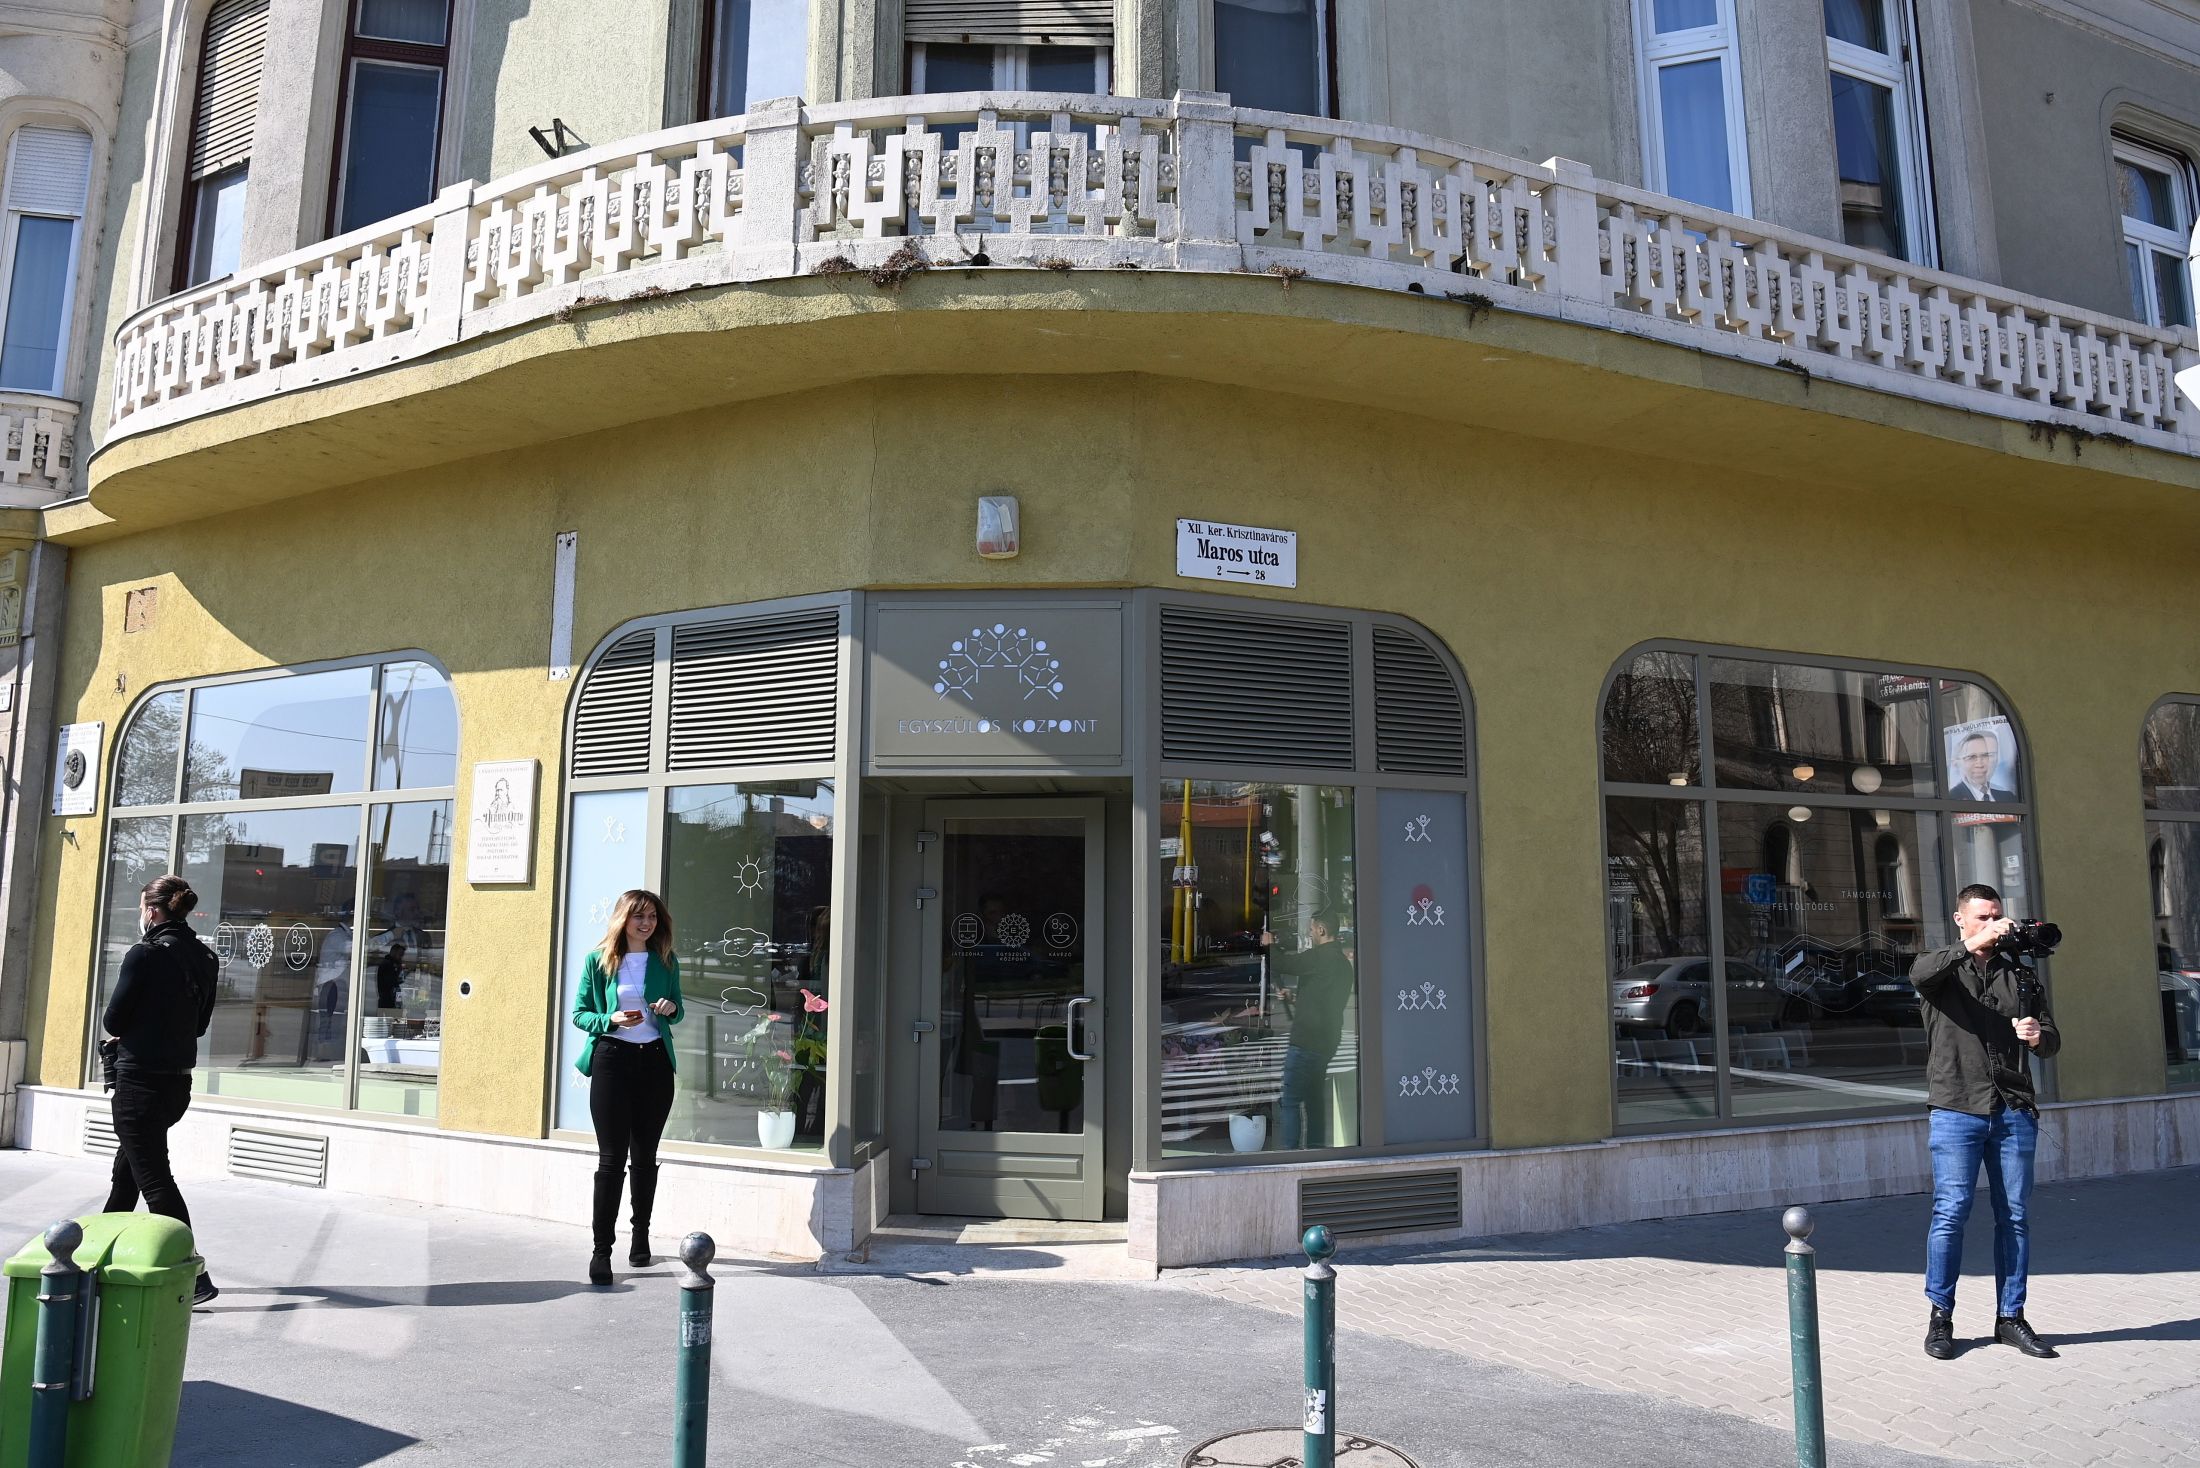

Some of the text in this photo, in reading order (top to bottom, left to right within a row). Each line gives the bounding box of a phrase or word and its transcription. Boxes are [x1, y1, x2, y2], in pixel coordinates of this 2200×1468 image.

[1208, 525, 1225, 536] ker.
[1227, 528, 1288, 543] Krisztinaváros
[1197, 538, 1279, 566] Maros utca
[1217, 566, 1266, 580] 2 28
[1012, 716, 1098, 733] KÖZPONT
[1841, 890, 1893, 899] TÁMOGATÁS
